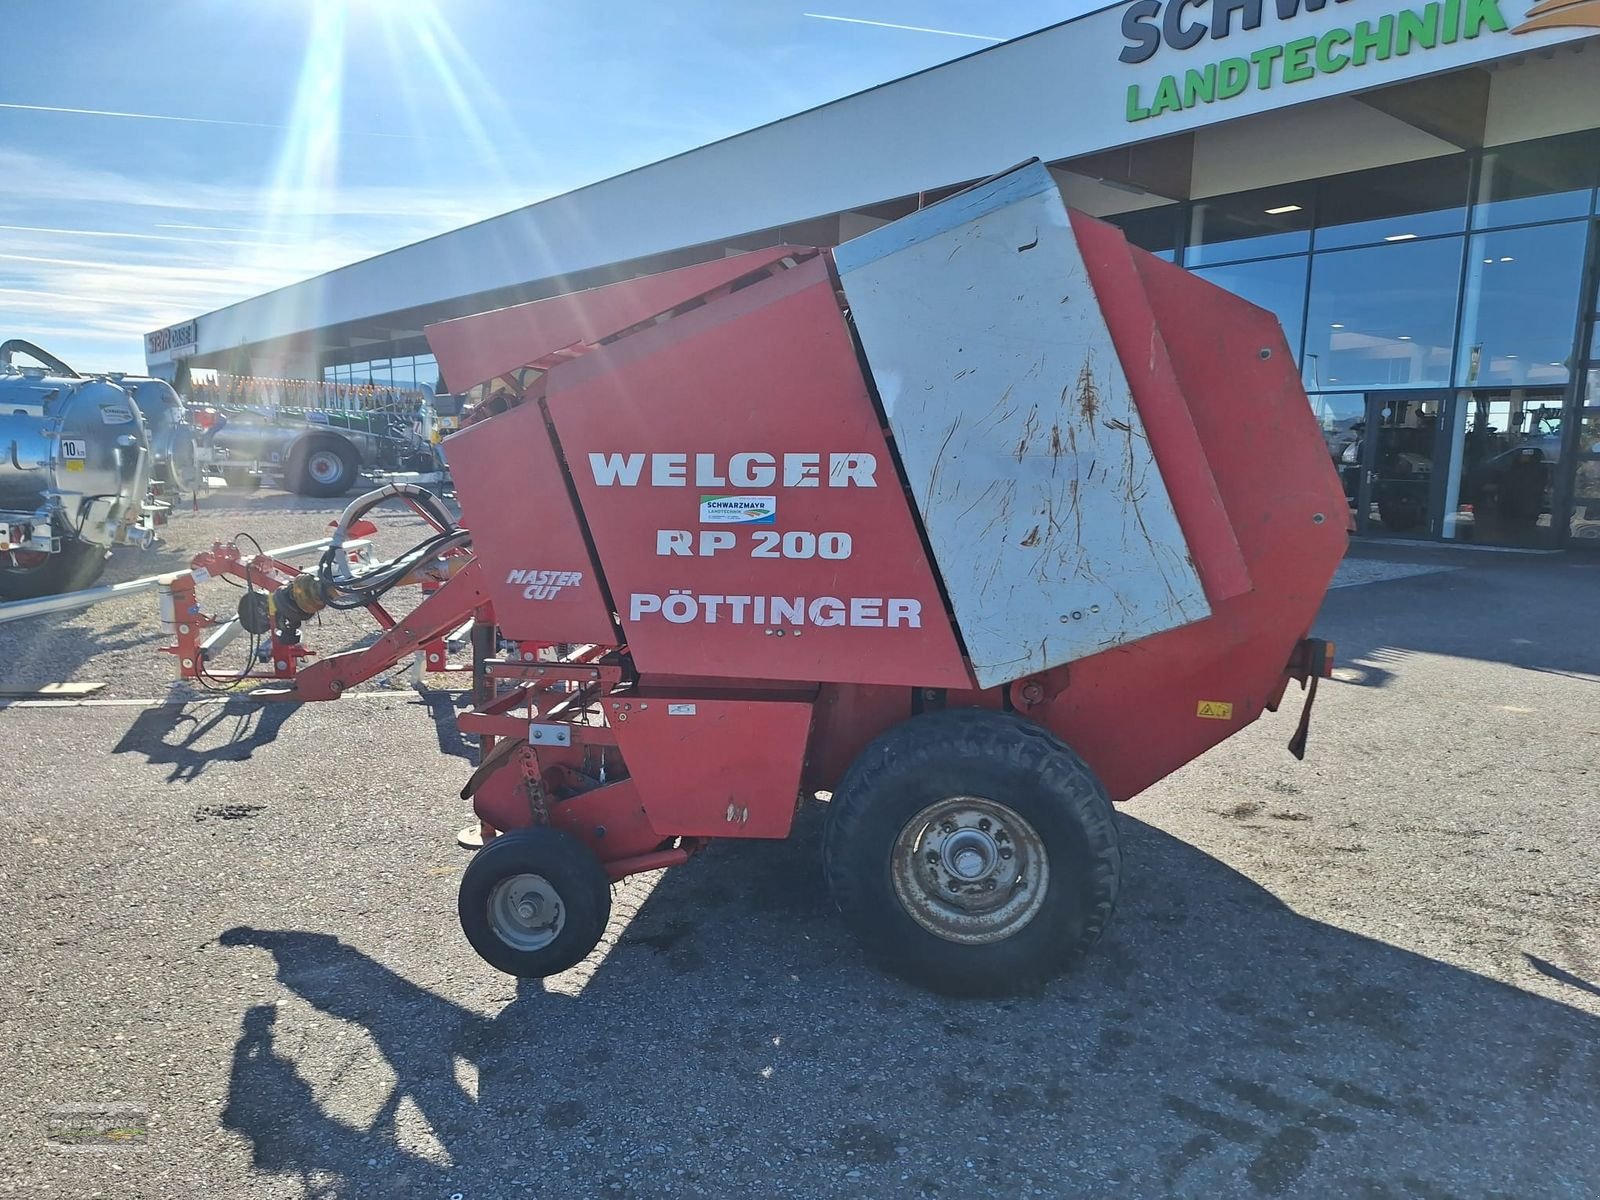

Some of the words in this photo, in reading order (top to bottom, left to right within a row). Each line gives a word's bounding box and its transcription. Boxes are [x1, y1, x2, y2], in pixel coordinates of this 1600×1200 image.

[1125, 0, 1509, 122] LANDTECHNIK
[63, 441, 76, 457] 10
[588, 452, 878, 488] WELGER
[656, 529, 736, 557] RP
[751, 531, 852, 560] 200
[505, 569, 583, 587] MASTER
[523, 585, 562, 600] CUT
[629, 589, 922, 628] PÖTTINGER
